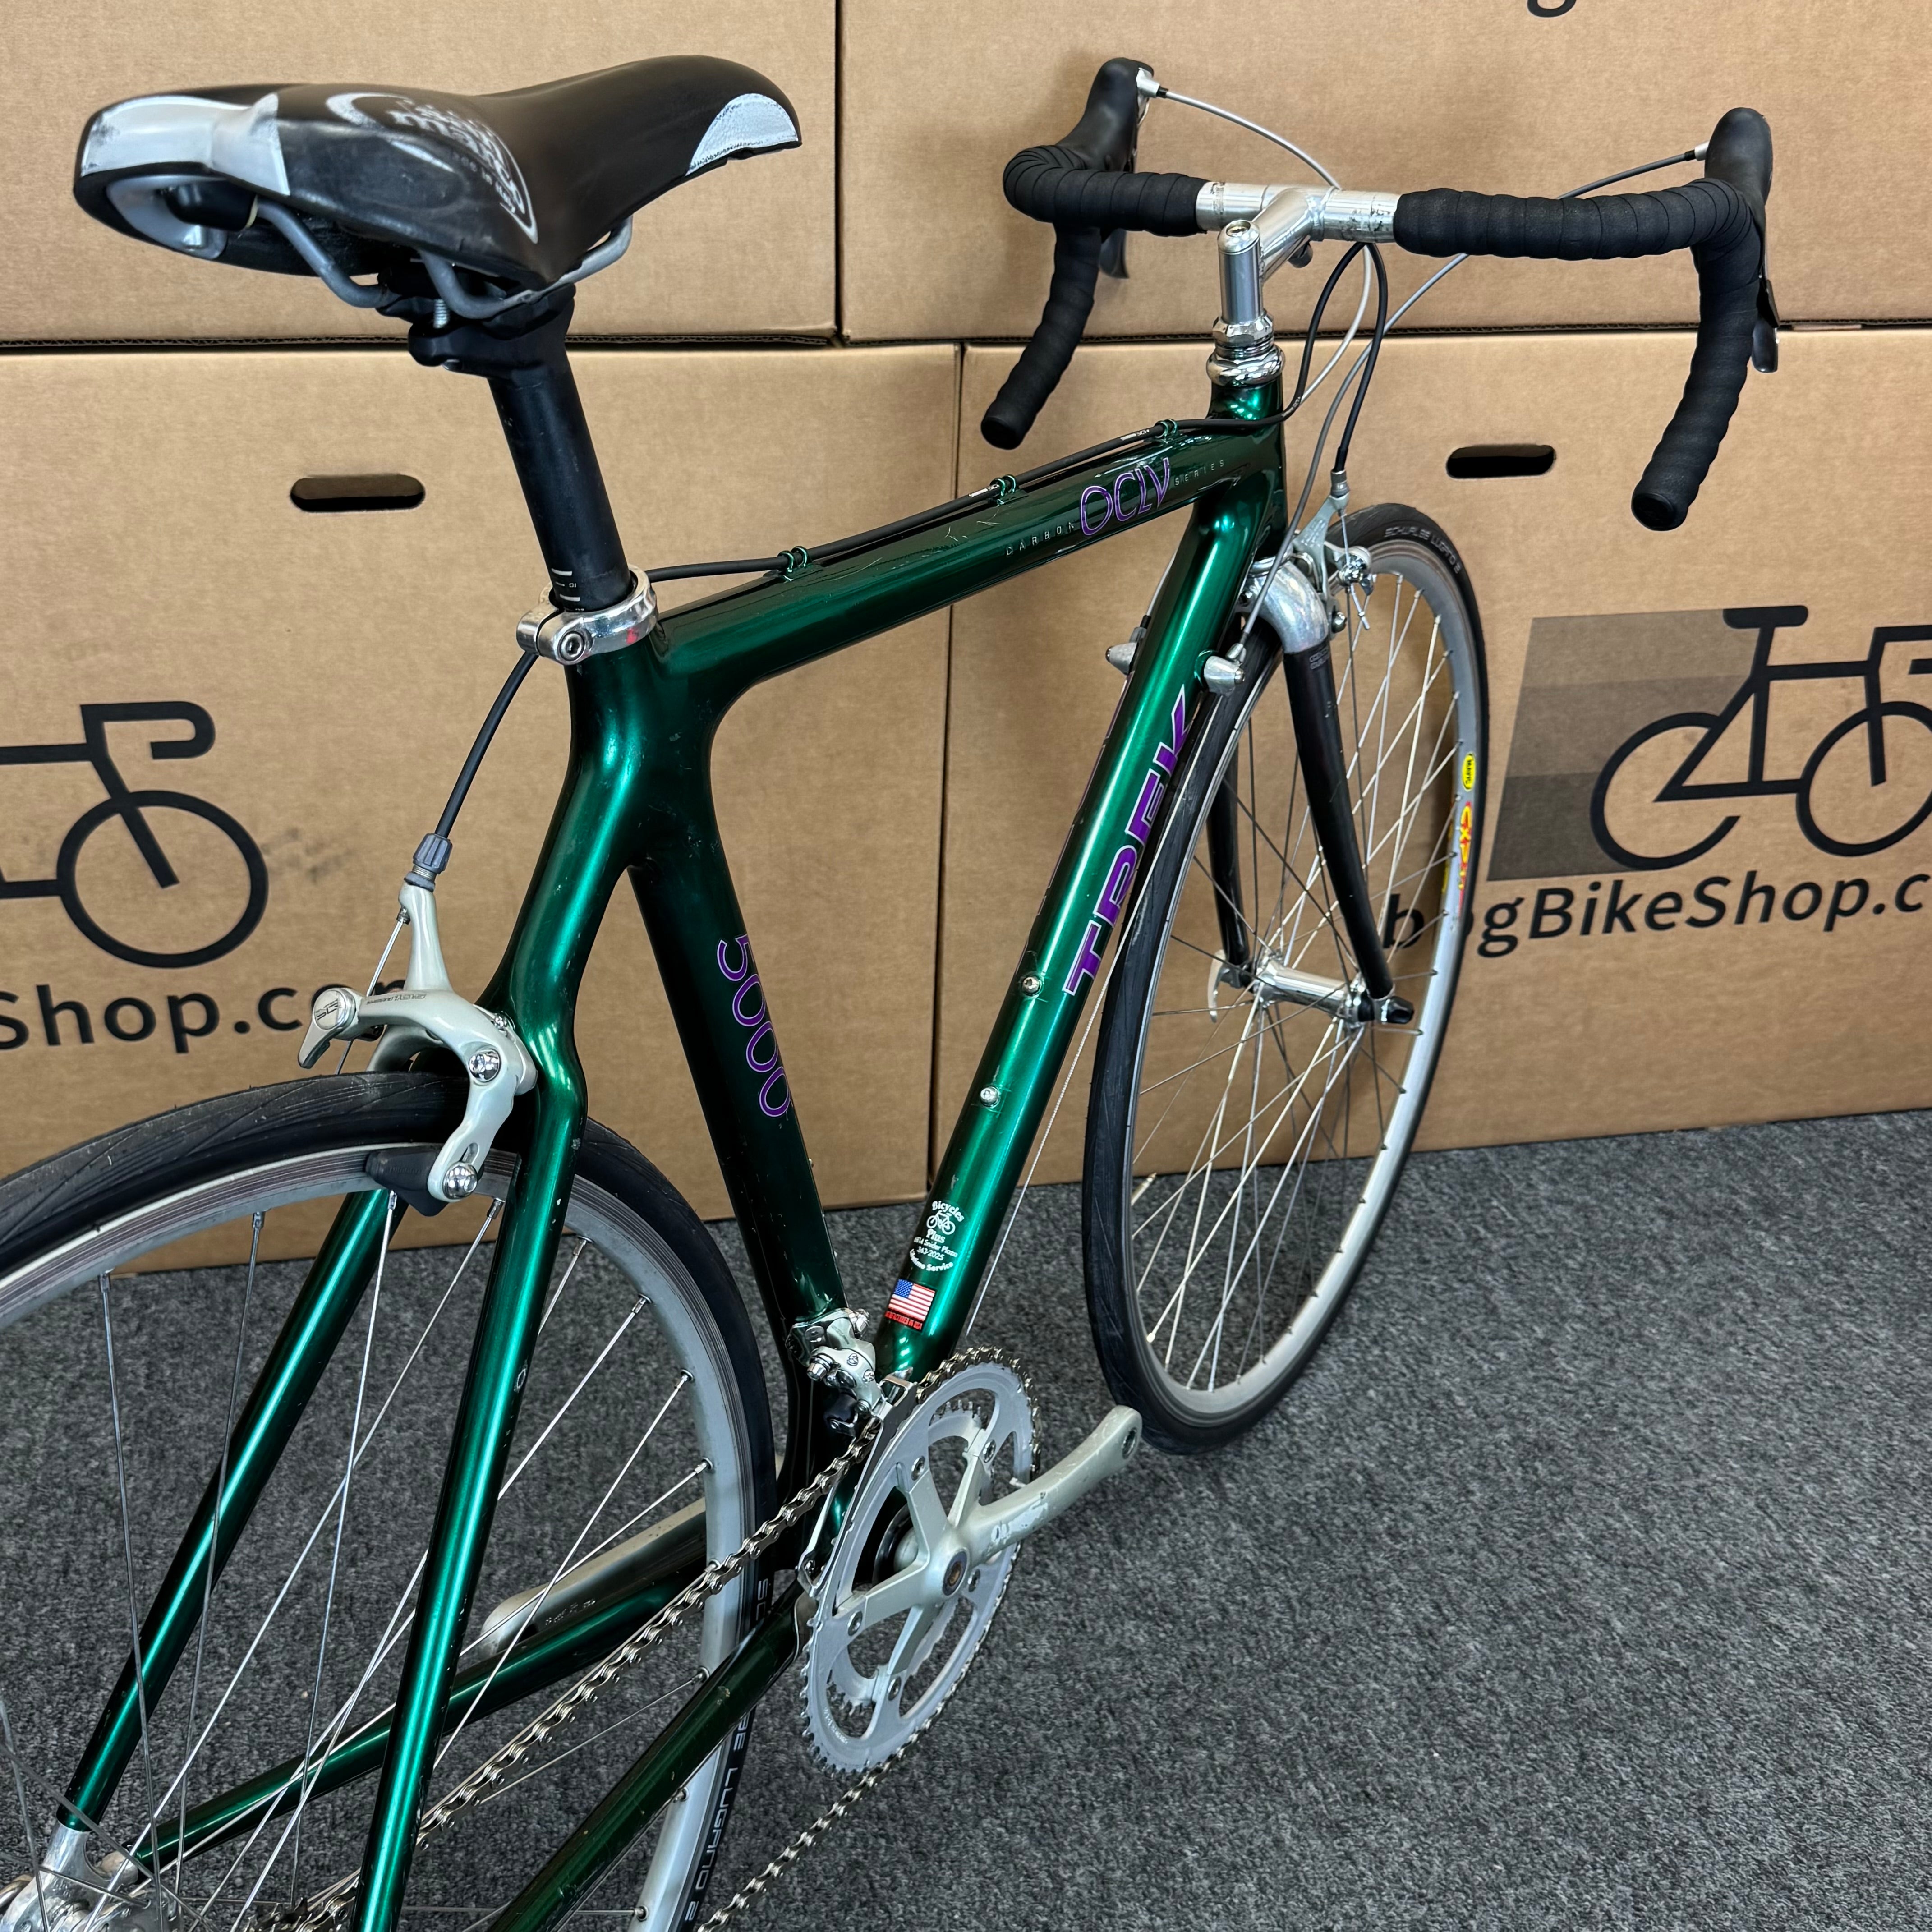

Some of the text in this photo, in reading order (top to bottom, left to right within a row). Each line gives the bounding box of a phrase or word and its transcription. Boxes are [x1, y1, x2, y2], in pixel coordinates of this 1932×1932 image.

[1080, 457, 1170, 536] OCLV
[1175, 460, 1225, 486] SERIES
[1062, 684, 1191, 996] TREK
[1382, 870, 1931, 958] bgBikeShop.c
[717, 934, 793, 1118] 5000
[926, 1228, 945, 1243] Plus
[932, 1201, 965, 1222] Bicycles
[926, 1262, 954, 1271] Service
[695, 1767, 739, 1890] LUGANO
[685, 1901, 699, 1921] 2
